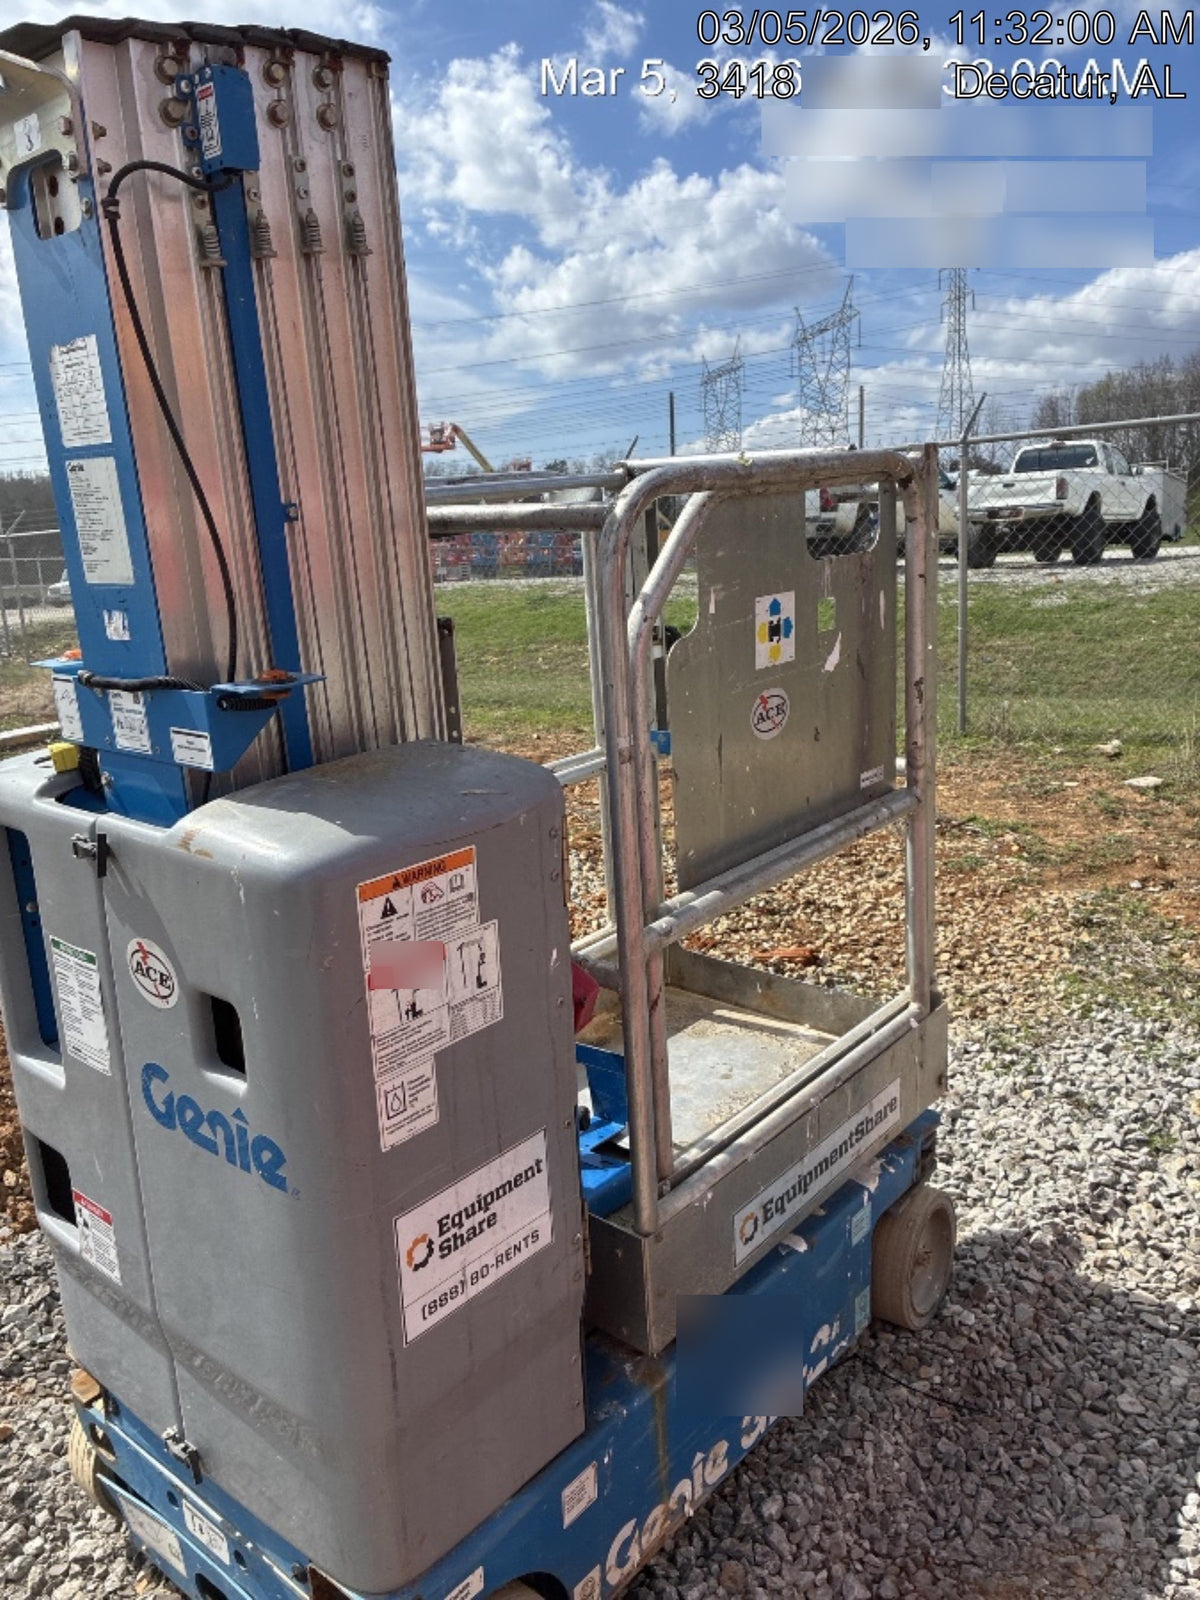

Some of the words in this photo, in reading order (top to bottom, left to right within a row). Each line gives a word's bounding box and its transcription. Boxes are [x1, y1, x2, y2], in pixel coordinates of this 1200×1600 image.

[755, 701, 786, 726] ACE
[401, 860, 447, 885] WARNING
[133, 959, 172, 990] ACE
[141, 1062, 289, 1193] Genie
[761, 1096, 898, 1225] EquipmentShare
[436, 1157, 544, 1238] Equipment
[438, 1211, 498, 1260] Share
[421, 1279, 467, 1321] (888)
